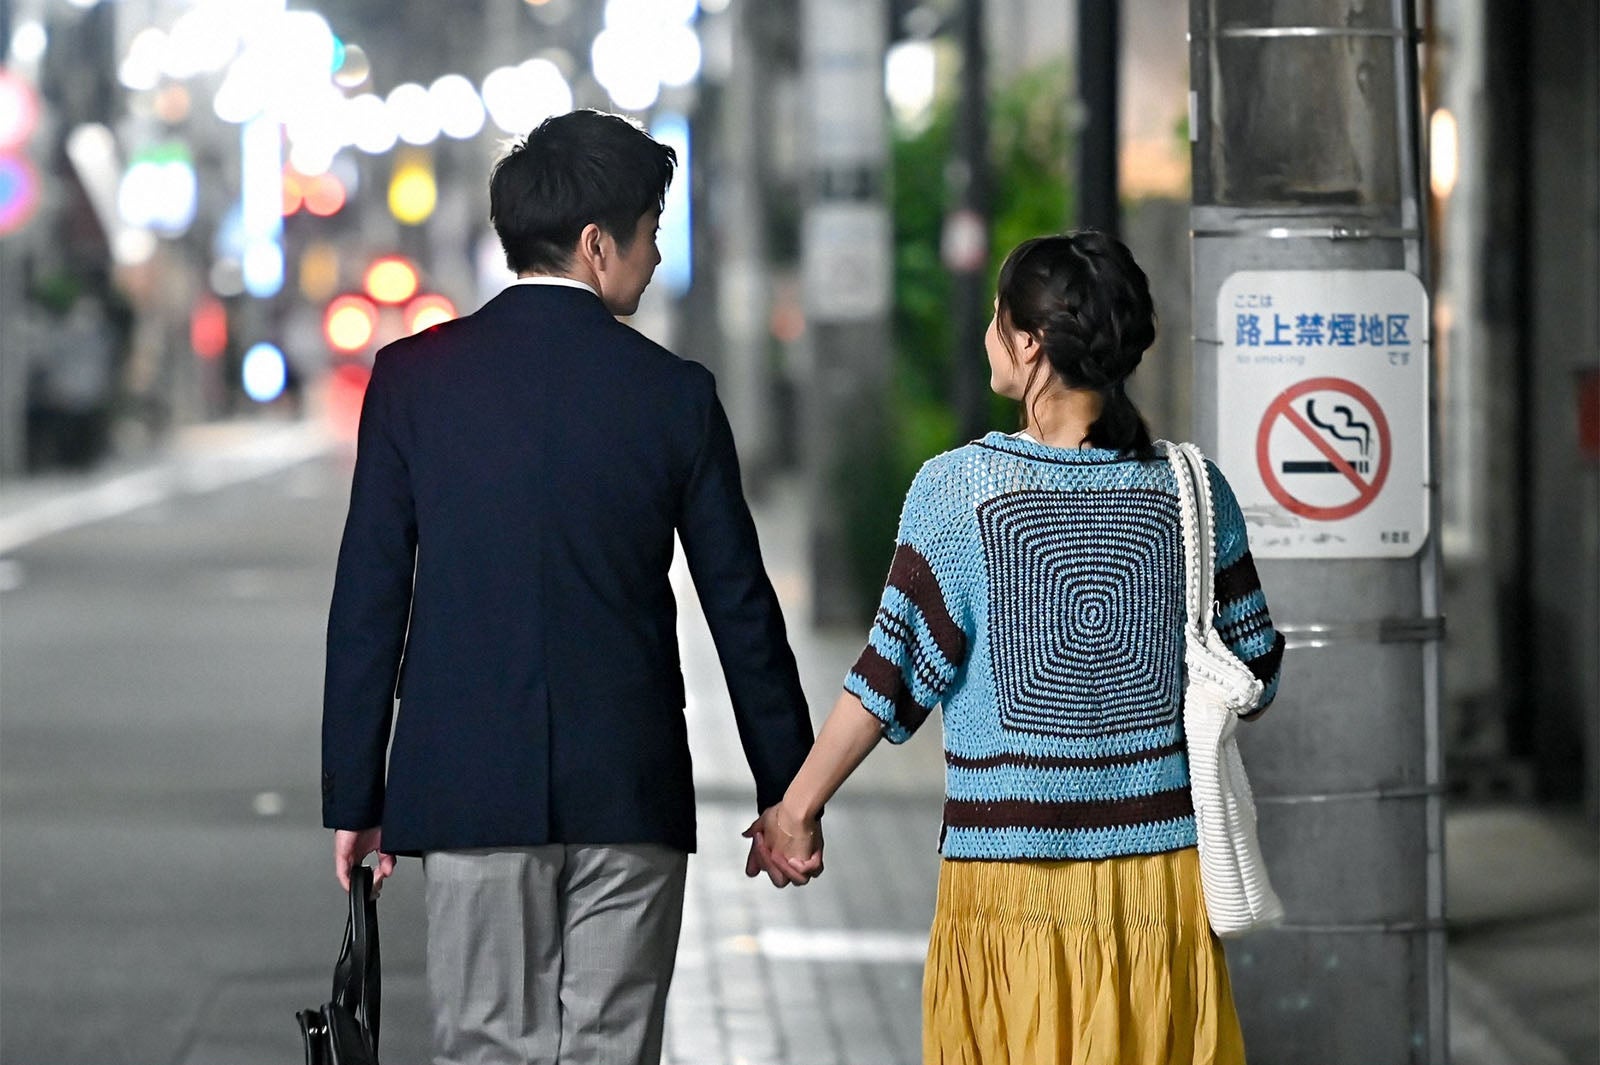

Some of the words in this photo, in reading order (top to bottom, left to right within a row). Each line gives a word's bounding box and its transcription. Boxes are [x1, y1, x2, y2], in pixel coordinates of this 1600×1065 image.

[1235, 294, 1273, 309] ここは
[1236, 313, 1411, 347] 路上禁煙地区
[1254, 354, 1305, 366] smoking
[1388, 351, 1410, 366] です
